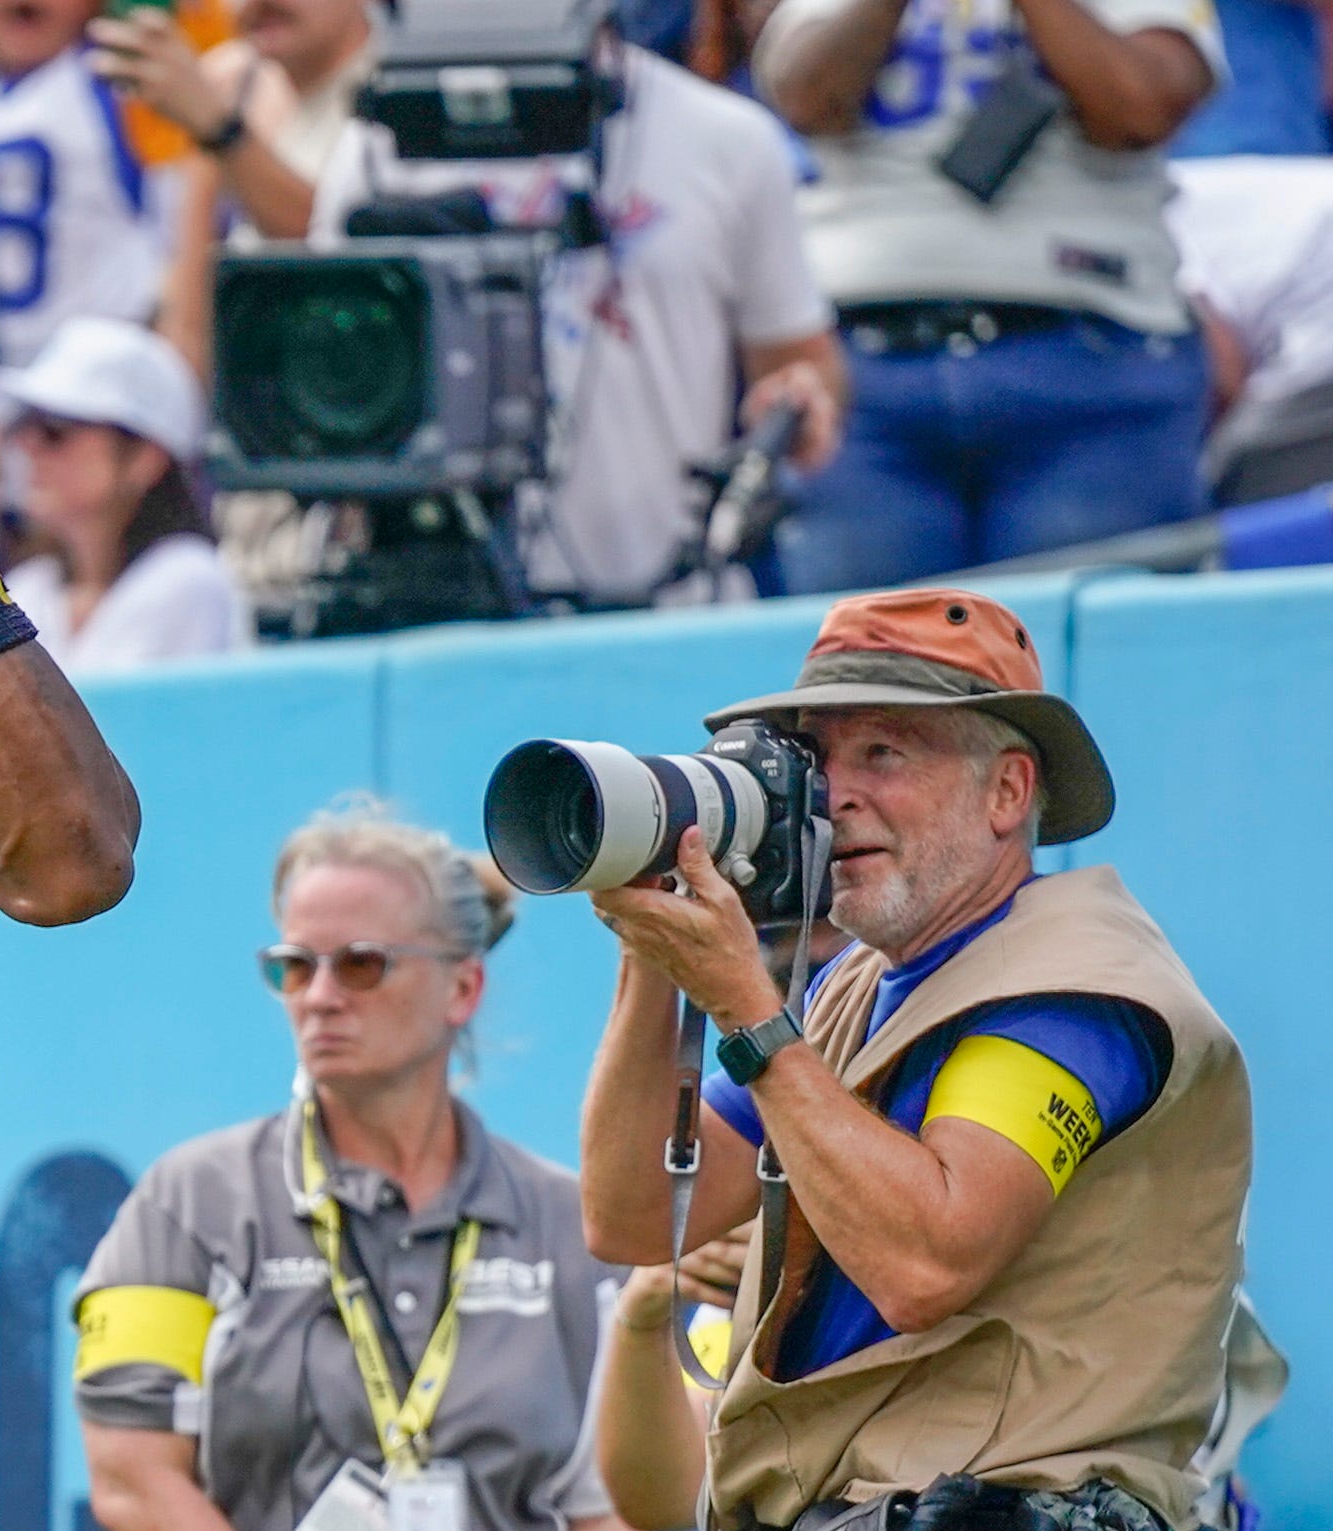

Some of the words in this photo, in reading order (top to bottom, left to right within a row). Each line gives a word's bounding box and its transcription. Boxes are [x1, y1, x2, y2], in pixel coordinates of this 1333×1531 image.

[714, 740, 746, 752] Canon
[1048, 1090, 1092, 1154] WEEK
[1081, 1100, 1098, 1125] TEN
